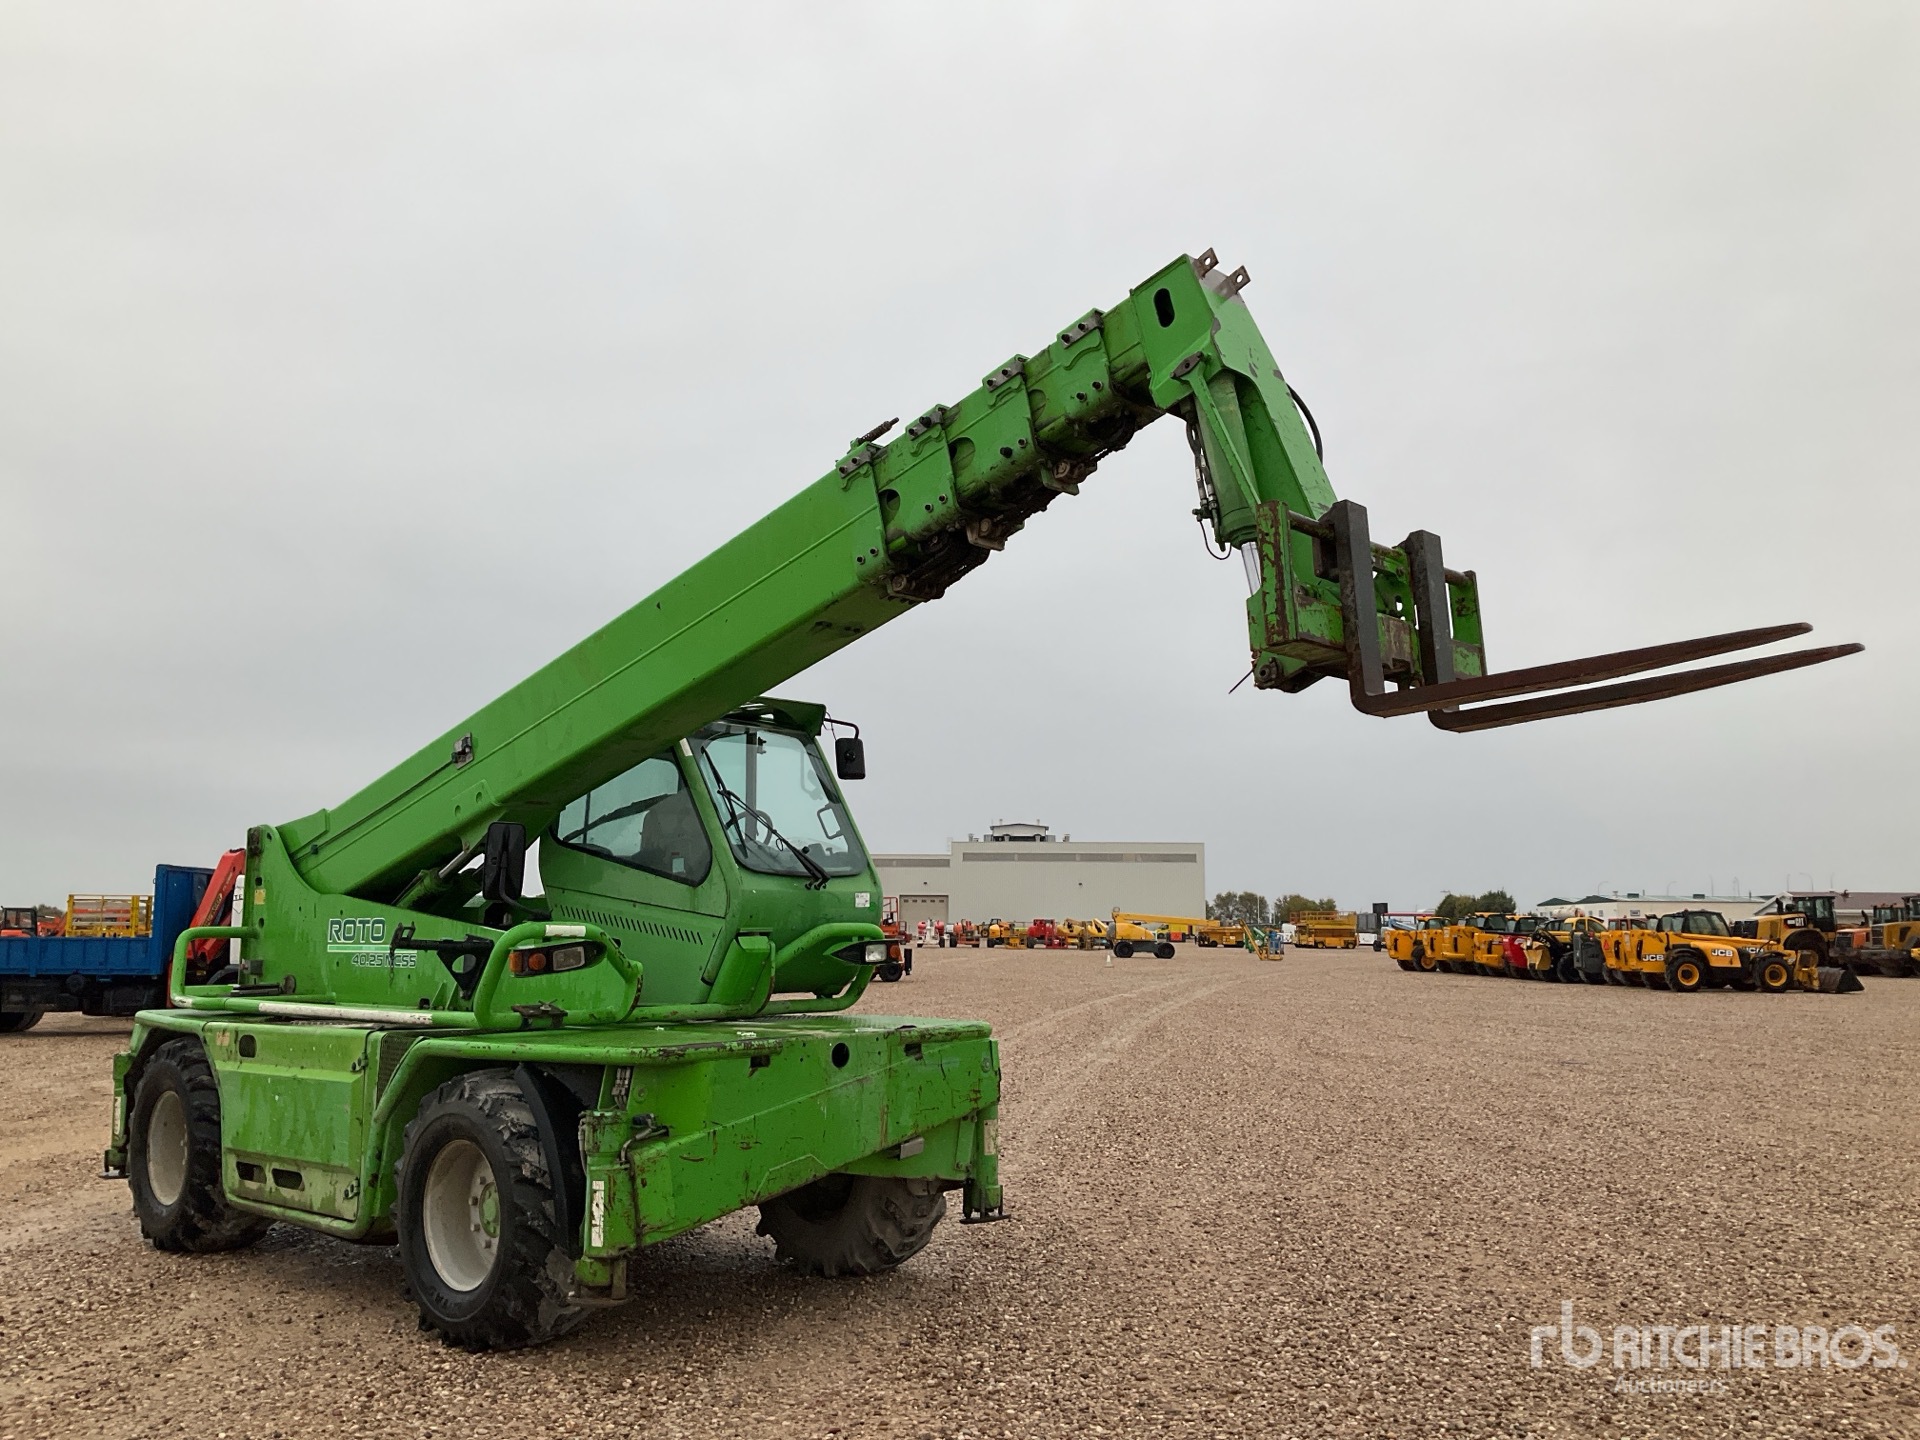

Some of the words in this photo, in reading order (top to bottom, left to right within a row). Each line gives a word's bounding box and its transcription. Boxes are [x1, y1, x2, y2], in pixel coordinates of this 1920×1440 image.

[327, 918, 386, 943] ROTO
[351, 953, 383, 967] 40.25
[1711, 949, 1733, 957] JCB
